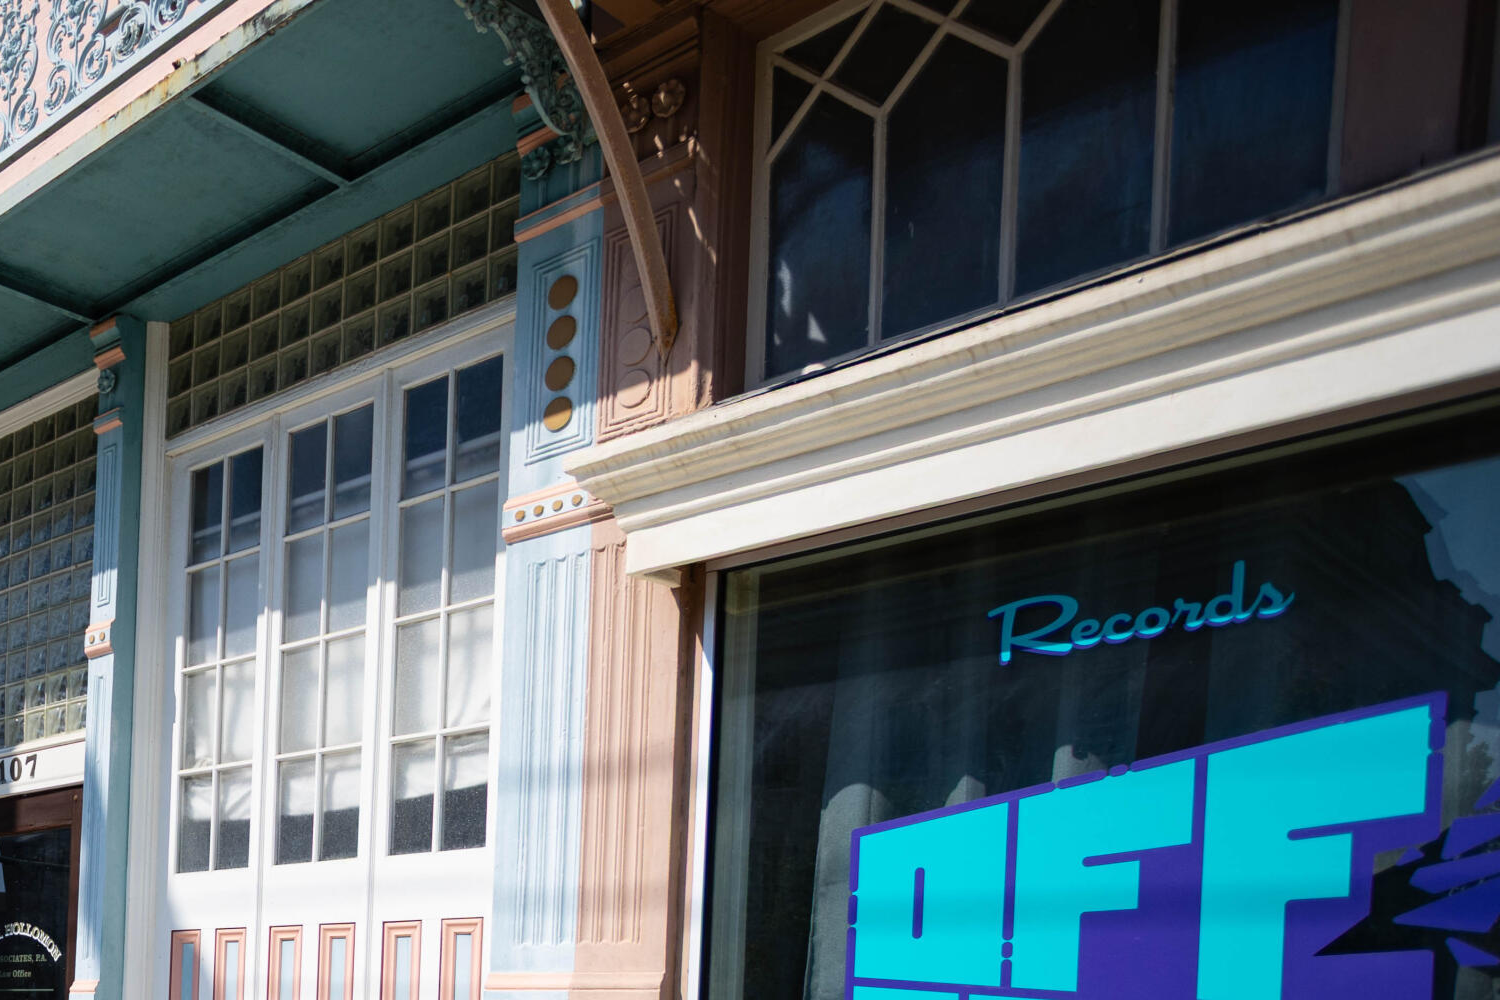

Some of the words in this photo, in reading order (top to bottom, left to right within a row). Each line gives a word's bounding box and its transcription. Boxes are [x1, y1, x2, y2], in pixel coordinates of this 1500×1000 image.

[987, 560, 1295, 666] Records
[4, 921, 62, 962] HOLLOMON
[35, 953, 47, 963] P.A.
[12, 969, 32, 978] Office
